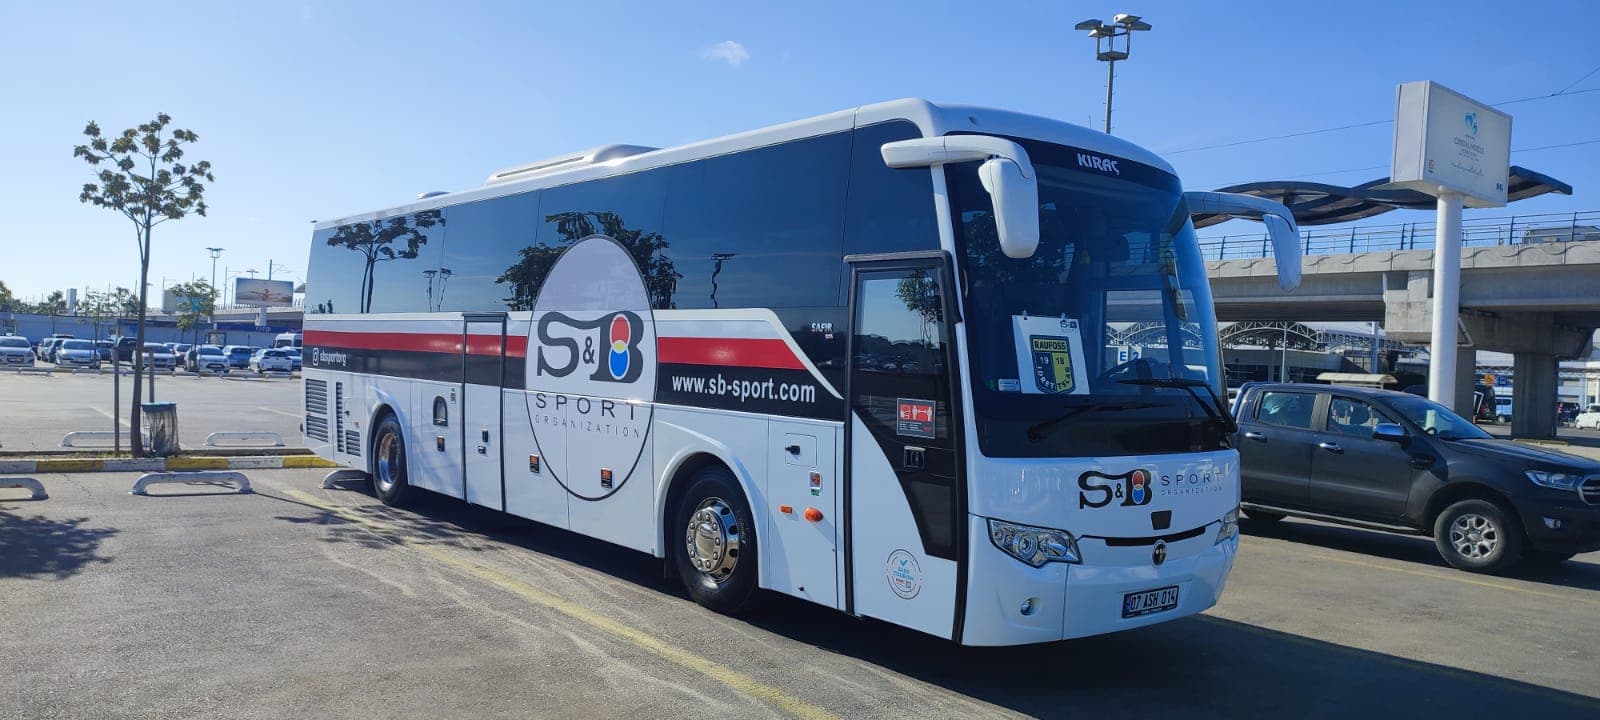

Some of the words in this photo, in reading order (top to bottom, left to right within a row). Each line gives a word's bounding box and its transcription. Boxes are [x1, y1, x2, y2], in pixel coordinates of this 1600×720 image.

[1077, 153, 1120, 176] KIRAÇ
[537, 310, 644, 384] S&B
[1034, 340, 1067, 351] RAUFOSS
[1039, 356, 1049, 365] 19
[1055, 357, 1065, 365] 18
[672, 373, 815, 403] www.sb-sport.com
[535, 392, 635, 421] SPORT
[535, 414, 641, 439] ORGANIZATION
[1077, 468, 1153, 509] S&B
[1161, 471, 1223, 486] SPORT
[1130, 595, 1142, 611] 07
[1143, 591, 1159, 609] ASH
[1161, 588, 1178, 605] 014
